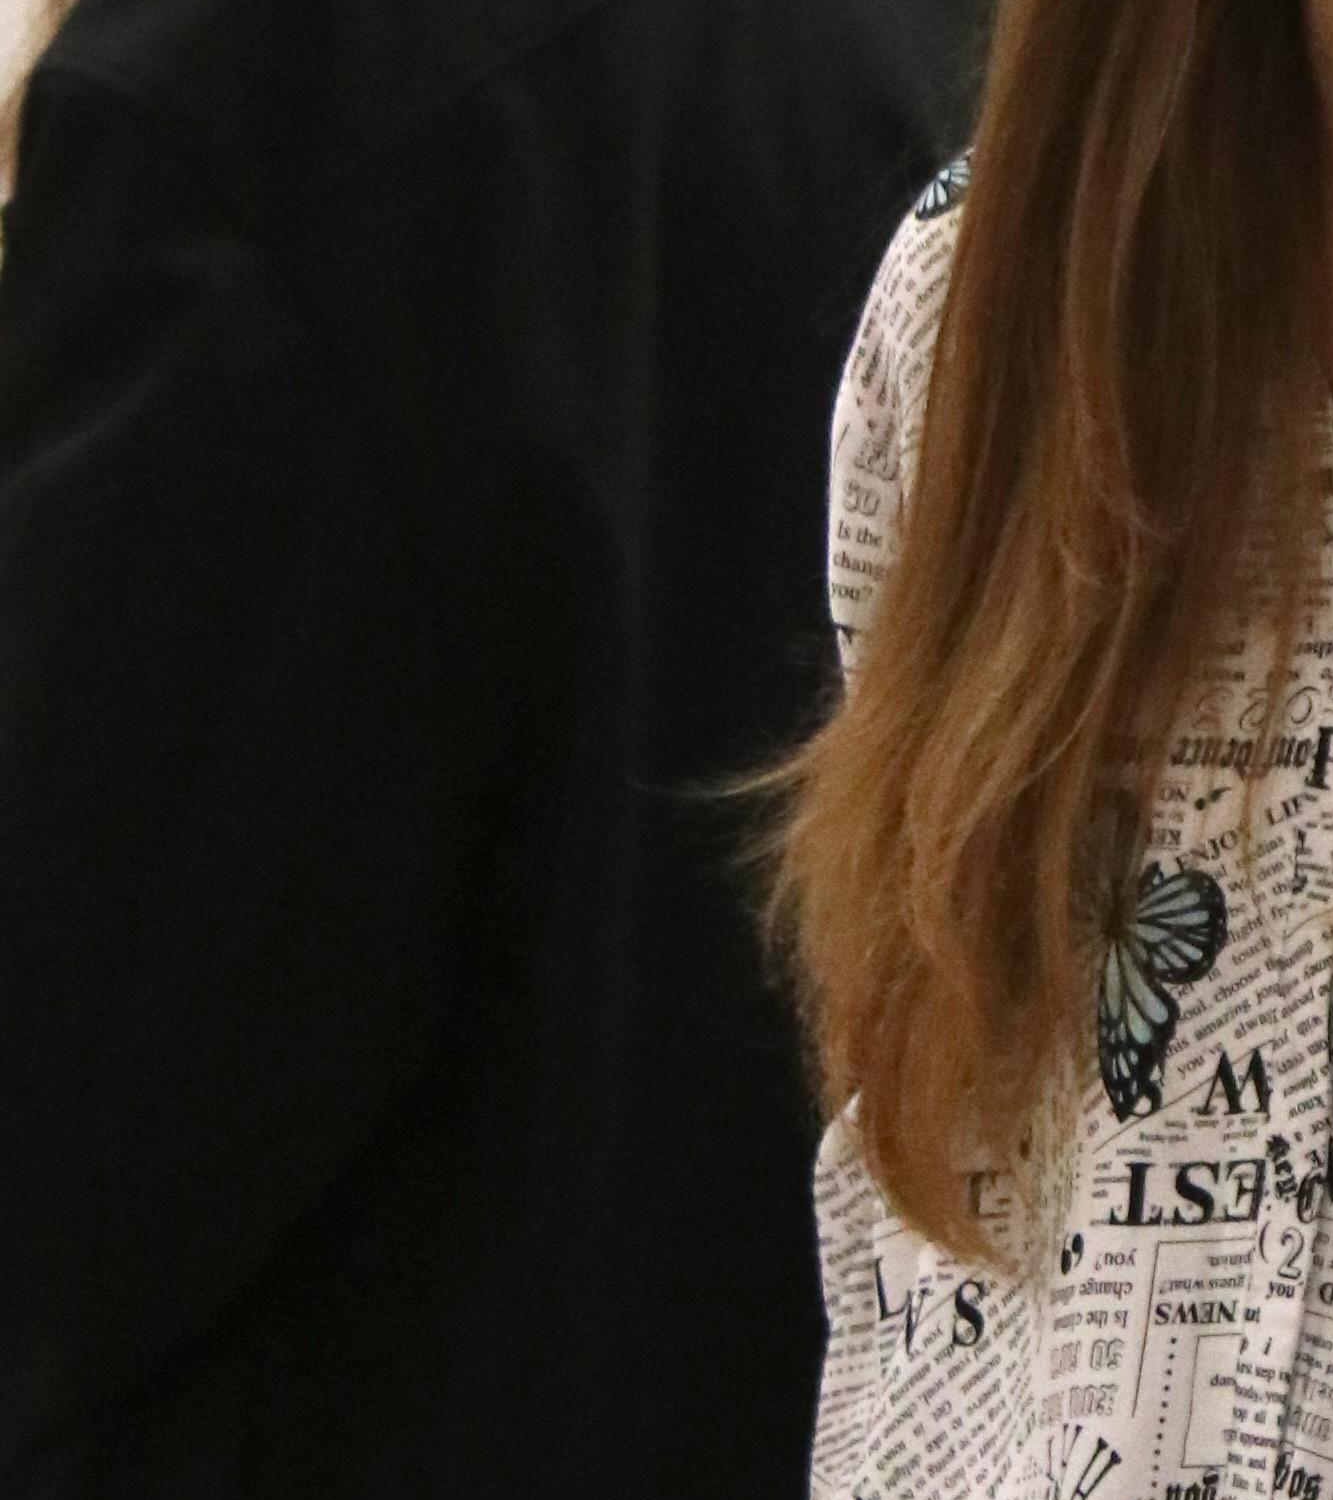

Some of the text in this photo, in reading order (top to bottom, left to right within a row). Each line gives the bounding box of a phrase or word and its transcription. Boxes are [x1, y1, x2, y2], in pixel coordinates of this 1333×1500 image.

[856, 524, 883, 546] the
[1094, 1250, 1137, 1270] you?
[1079, 1279, 1133, 1300] change
[1086, 1311, 1108, 1330] the
[1155, 1300, 1239, 1325] NEWS
